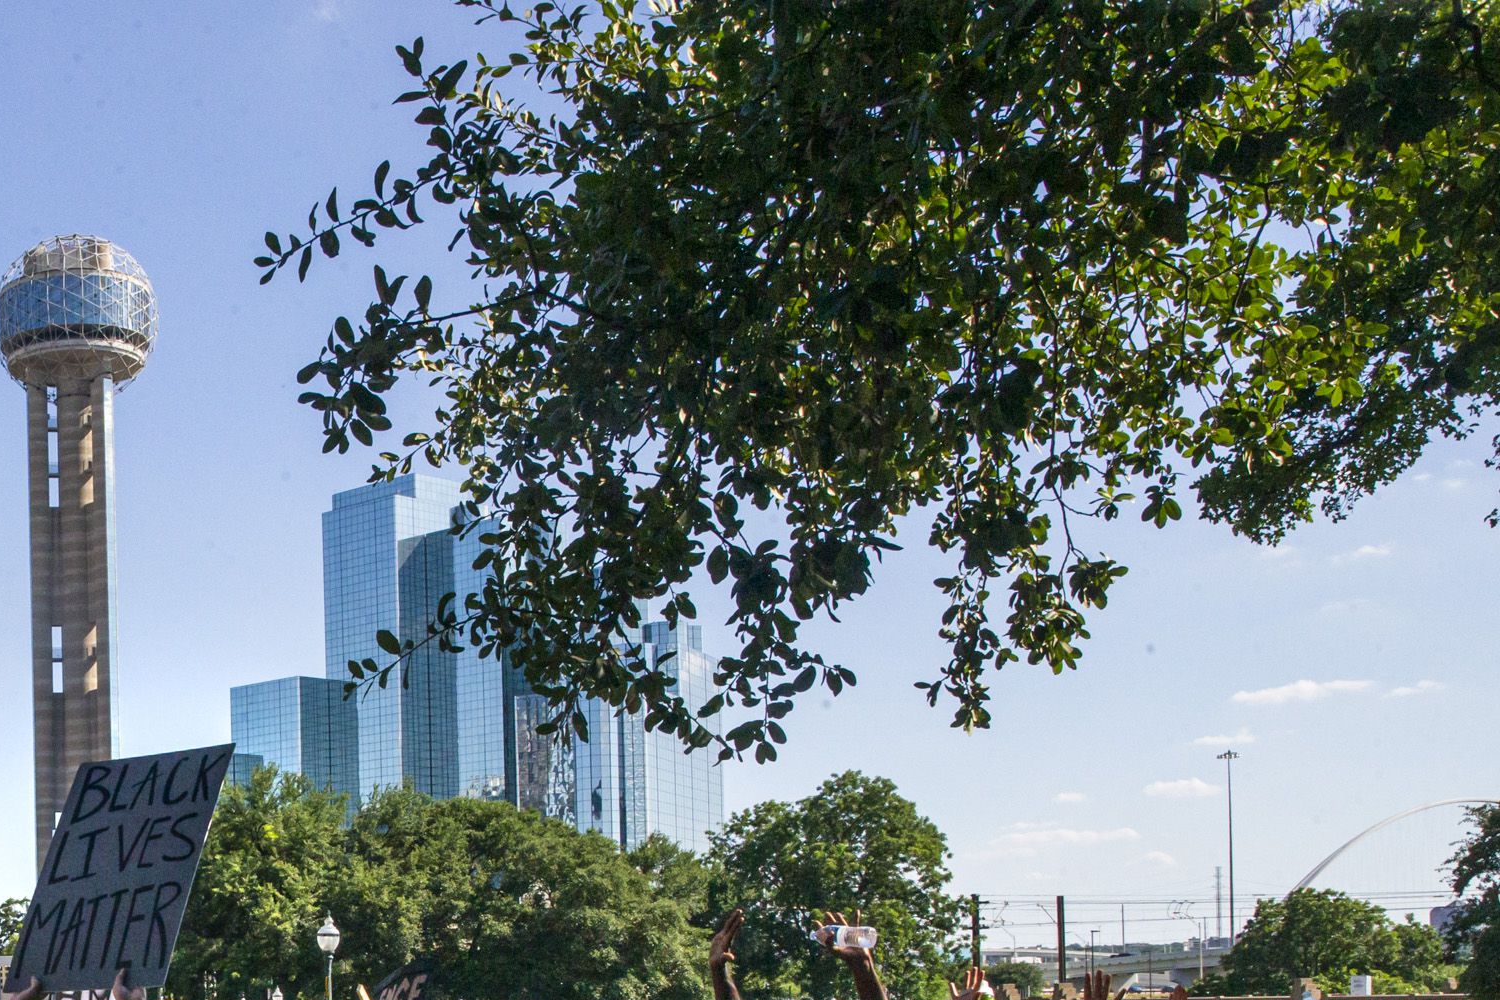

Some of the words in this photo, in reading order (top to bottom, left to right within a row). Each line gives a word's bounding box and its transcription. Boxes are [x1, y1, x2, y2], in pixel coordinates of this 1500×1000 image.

[70, 753, 226, 825] BLACK
[48, 812, 199, 886] LIVES
[14, 881, 183, 980] MATTER
